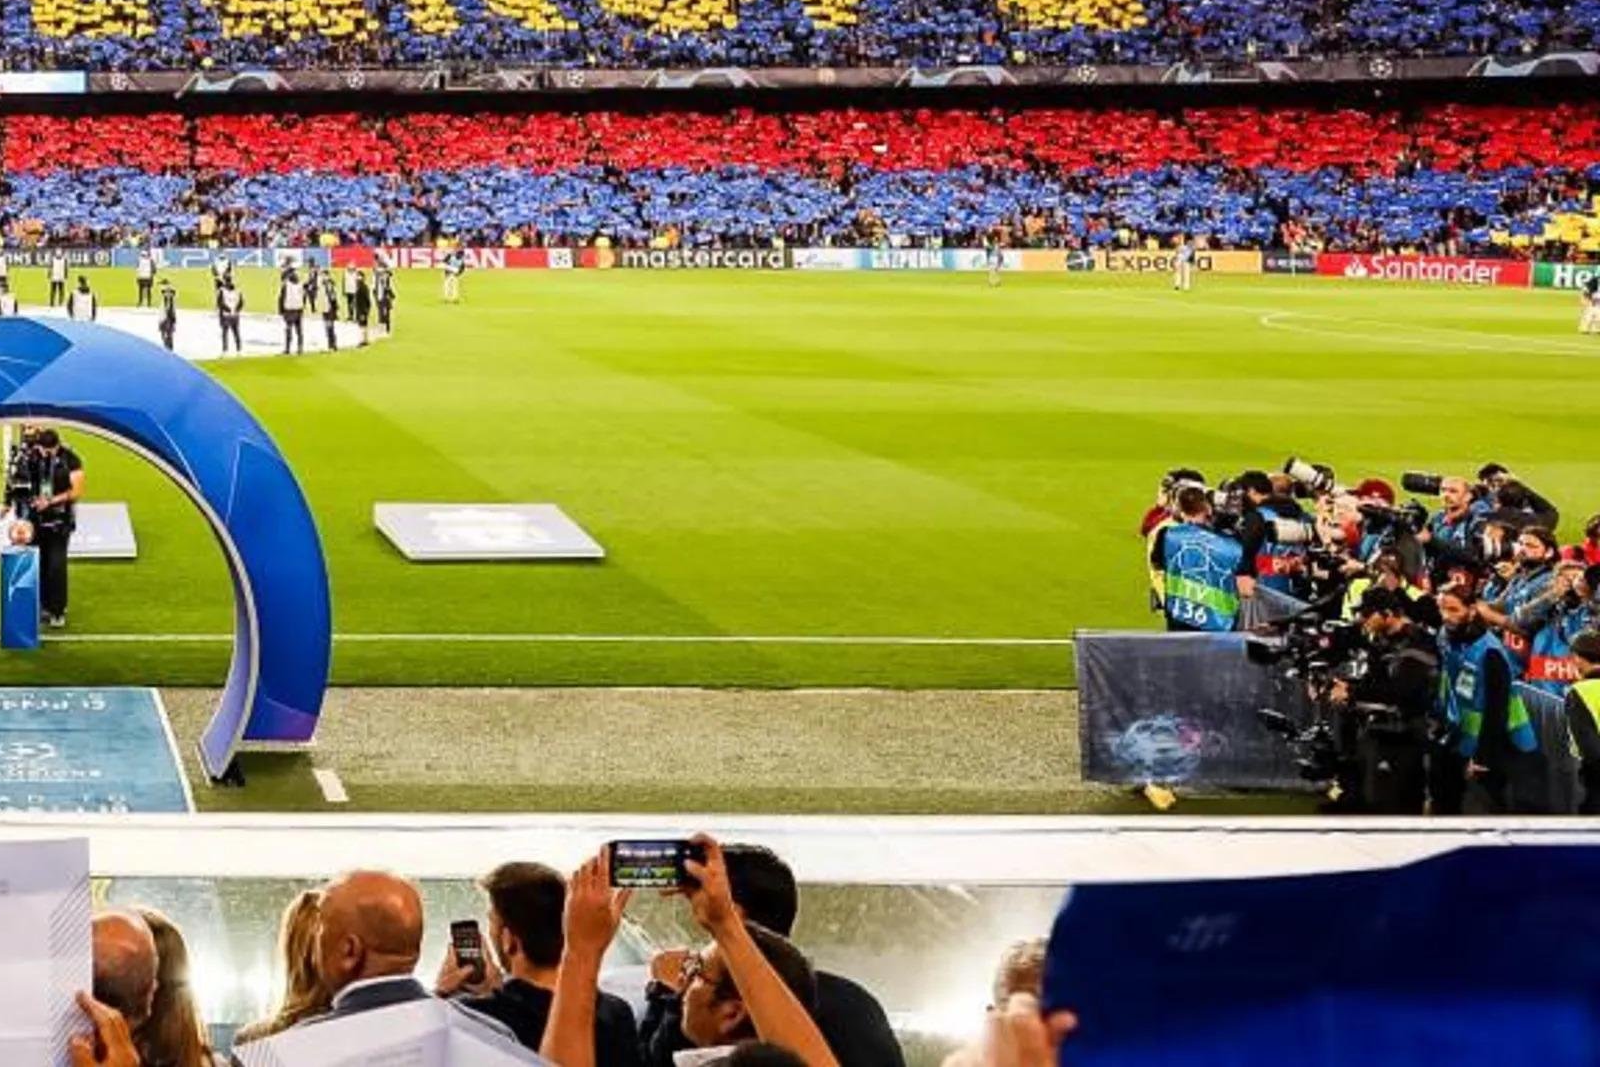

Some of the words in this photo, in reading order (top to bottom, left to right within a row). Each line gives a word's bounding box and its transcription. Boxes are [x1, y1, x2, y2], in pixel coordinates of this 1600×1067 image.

[622, 245, 786, 269] mastercard
[1105, 251, 1213, 272] Expea
[1370, 255, 1502, 283] Santander
